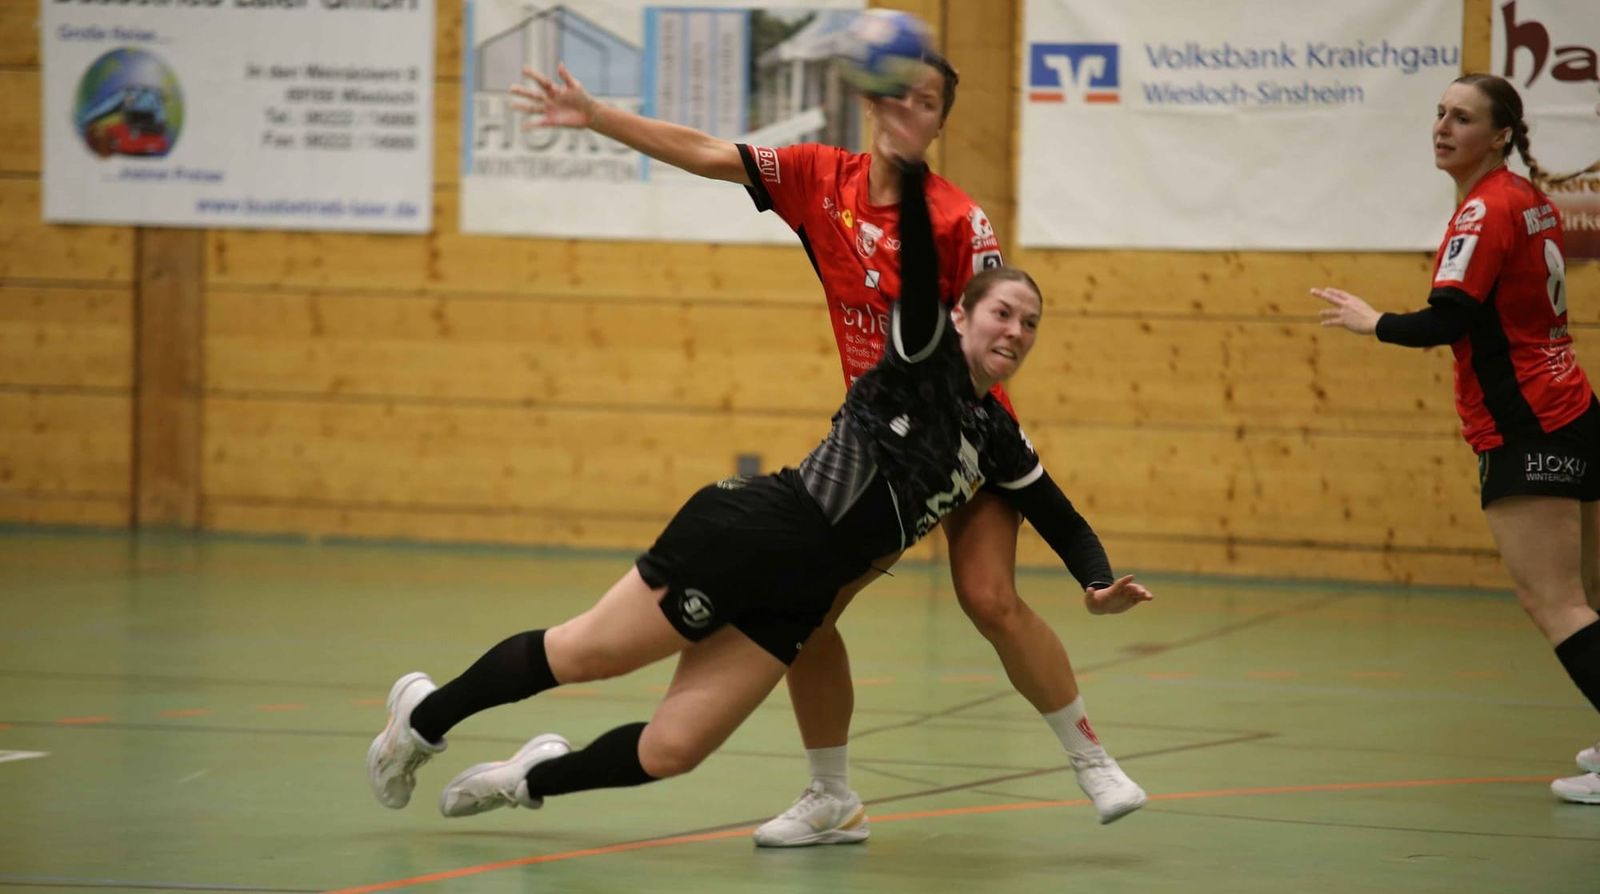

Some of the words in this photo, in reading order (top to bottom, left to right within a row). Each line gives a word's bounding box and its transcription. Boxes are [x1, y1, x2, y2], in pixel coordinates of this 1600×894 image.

[1144, 42, 1296, 70] Volksbank
[1306, 40, 1459, 74] Kraichgau
[1142, 81, 1364, 105] Wiesloch-Sinsheim
[1544, 238, 1567, 317] 8
